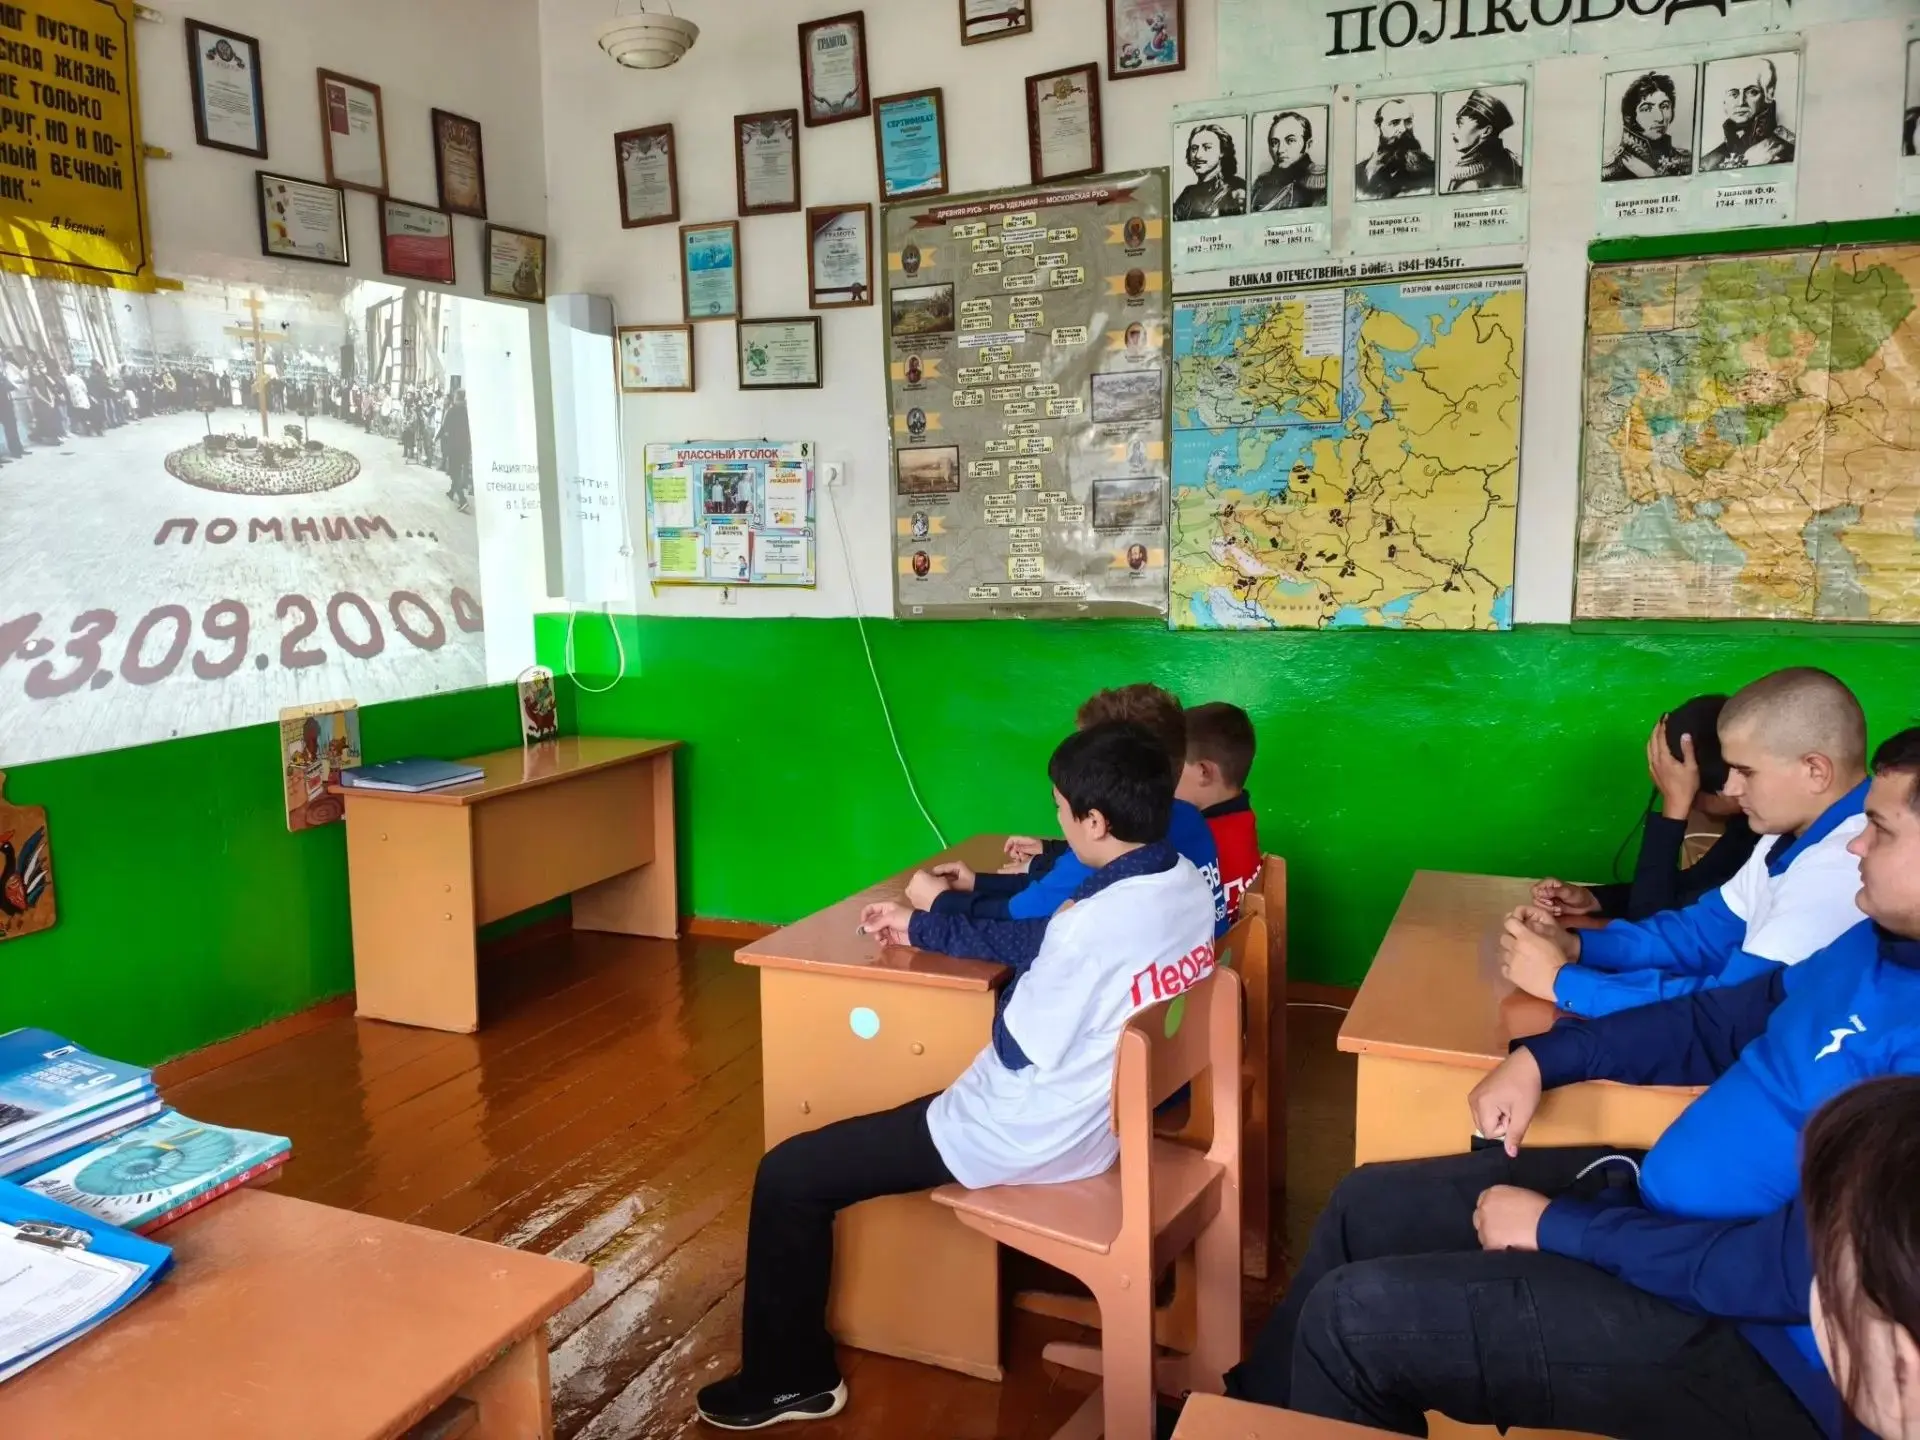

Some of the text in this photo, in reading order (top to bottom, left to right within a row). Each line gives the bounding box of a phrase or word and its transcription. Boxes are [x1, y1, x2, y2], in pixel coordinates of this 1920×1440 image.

[36, 13, 89, 52] ПУСТА
[94, 33, 117, 60] ЧЕ-
[55, 54, 121, 95] ЖИЗНЬ.
[29, 80, 102, 121] ТОЛЬКО
[886, 114, 934, 130] СЕРТИФИКАТ
[0, 106, 122, 156] РУГ, НО И ПО-
[50, 153, 123, 191] ВЕЧНЫЙ
[937, 189, 1109, 218] ДРЕВНЯЯ РУСЬ РУСЬ УДЕЛЬНАЯ МОСКОВСКАЯ РУСЬ
[1615, 198, 1659, 208] Багратион
[1715, 200, 1734, 208] 1744
[1745, 197, 1763, 206] 1817
[1454, 210, 1489, 219] Нахимов
[1618, 209, 1637, 218] 1765
[1646, 206, 1664, 215] 1812
[1368, 218, 1402, 227] Макаров
[1479, 218, 1496, 226] 1855
[1392, 226, 1409, 235] 1904
[1264, 239, 1280, 247] 1788
[1287, 236, 1302, 244] 1851
[1229, 271, 1272, 287] ВЕЛИКАЯ
[1402, 278, 1522, 294] РАЗГРОМ ФАШИСТСКОЙ ГЕРМАНИИ
[677, 448, 779, 460] КЛАССНЫЙ УГОЛОК
[801, 443, 809, 457] 8
